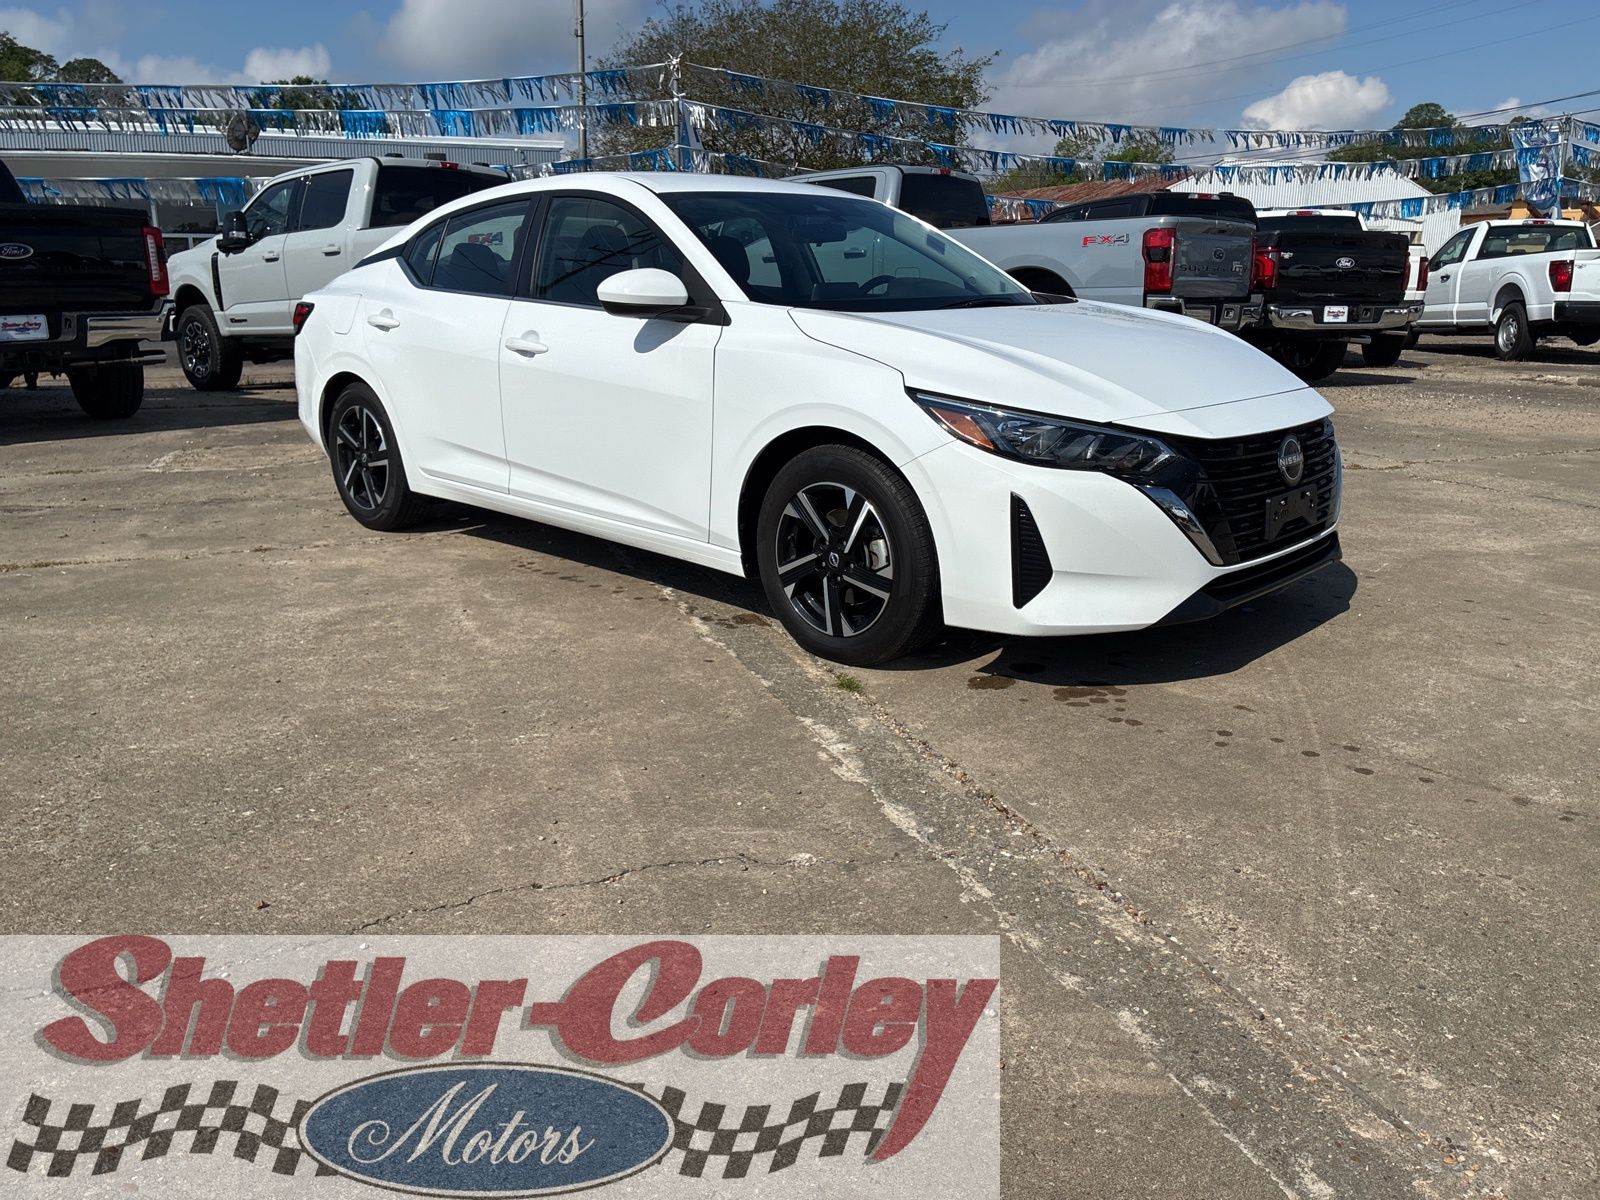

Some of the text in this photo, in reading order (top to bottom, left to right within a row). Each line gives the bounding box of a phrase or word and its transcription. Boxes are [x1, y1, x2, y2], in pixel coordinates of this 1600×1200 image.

[1081, 233, 1130, 247] FX4
[1, 246, 26, 257] Ford
[1338, 258, 1353, 268] Ford
